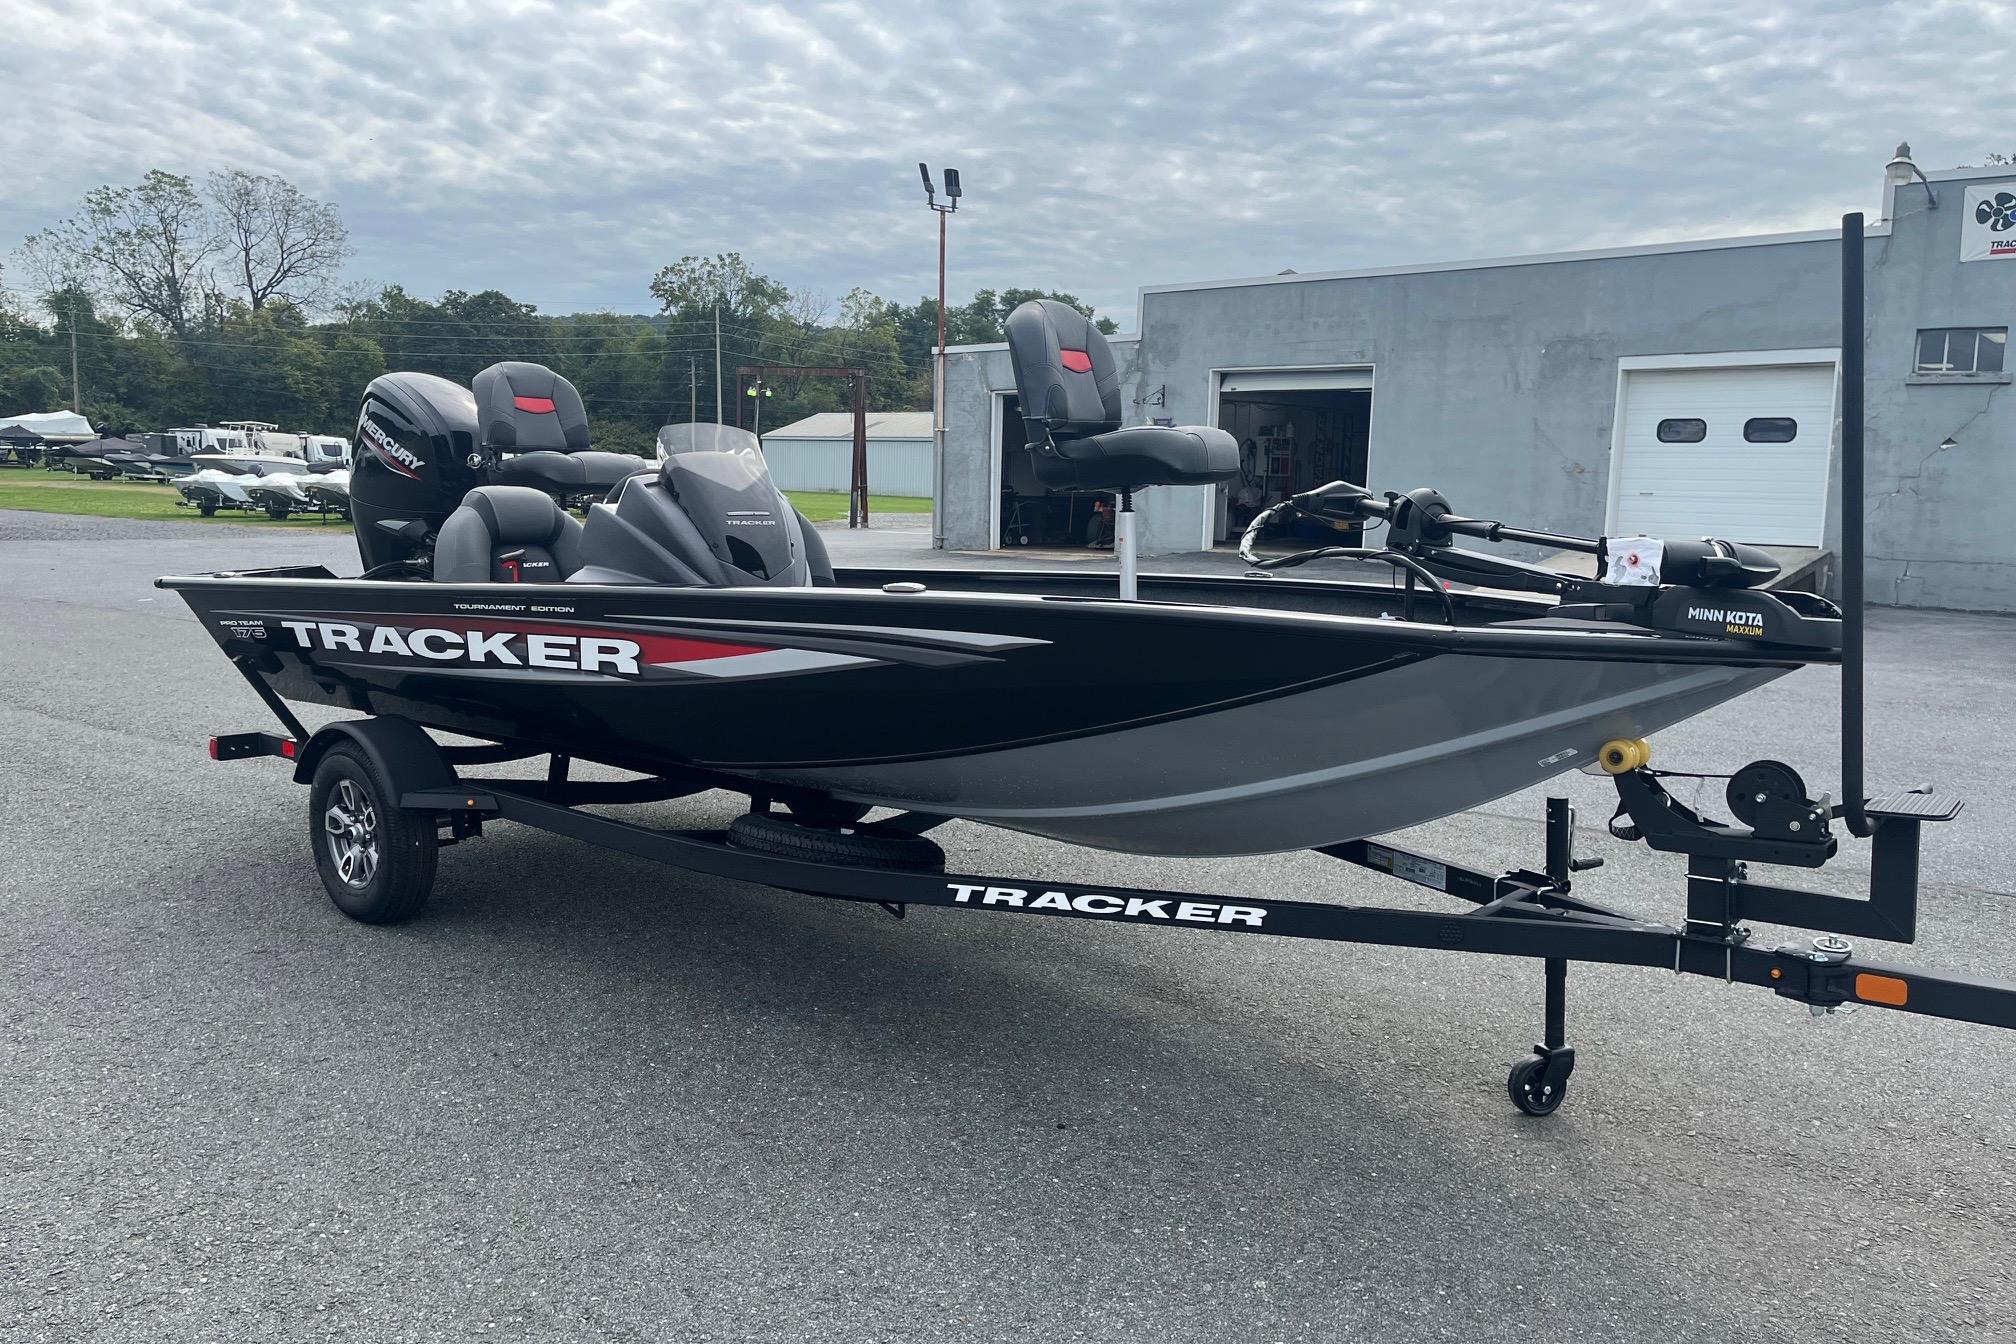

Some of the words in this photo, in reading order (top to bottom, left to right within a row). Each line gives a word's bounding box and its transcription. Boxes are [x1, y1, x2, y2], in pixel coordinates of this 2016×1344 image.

[361, 414, 426, 470] MERCURY
[453, 603, 526, 611] TOURNAMENT
[531, 605, 575, 613] EDITION
[1687, 606, 1724, 623] MINN
[1725, 610, 1764, 627] KOTA
[230, 626, 267, 639] 175
[1726, 624, 1763, 636] MAXXUM
[280, 621, 641, 675] TRACKER
[947, 883, 1268, 927] TRACKER
